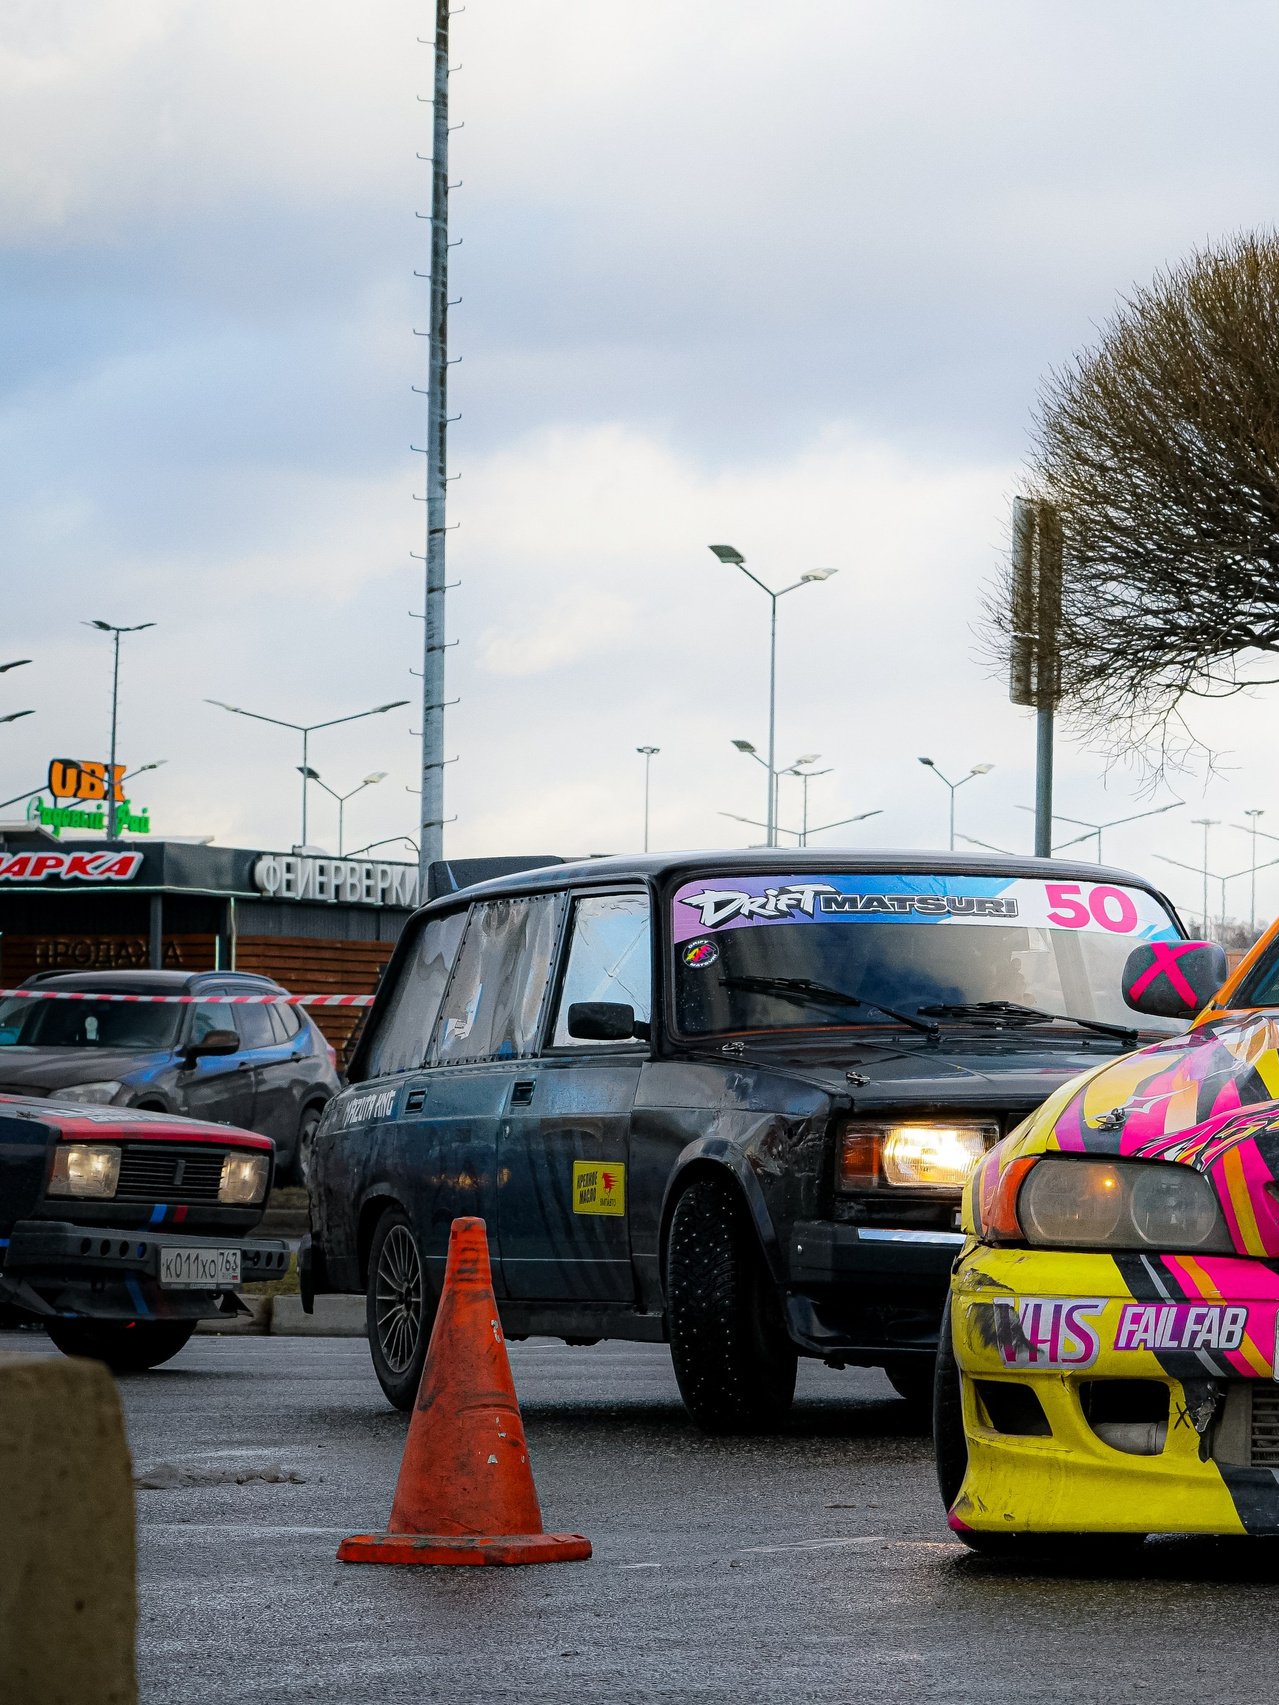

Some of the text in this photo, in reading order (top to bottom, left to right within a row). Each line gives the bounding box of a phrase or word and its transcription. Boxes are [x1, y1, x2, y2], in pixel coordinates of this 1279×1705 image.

[0, 852, 142, 880] АРКА
[820, 894, 1019, 918] MATSURI
[1045, 884, 1138, 934] 50
[219, 1252, 239, 1272] 763
